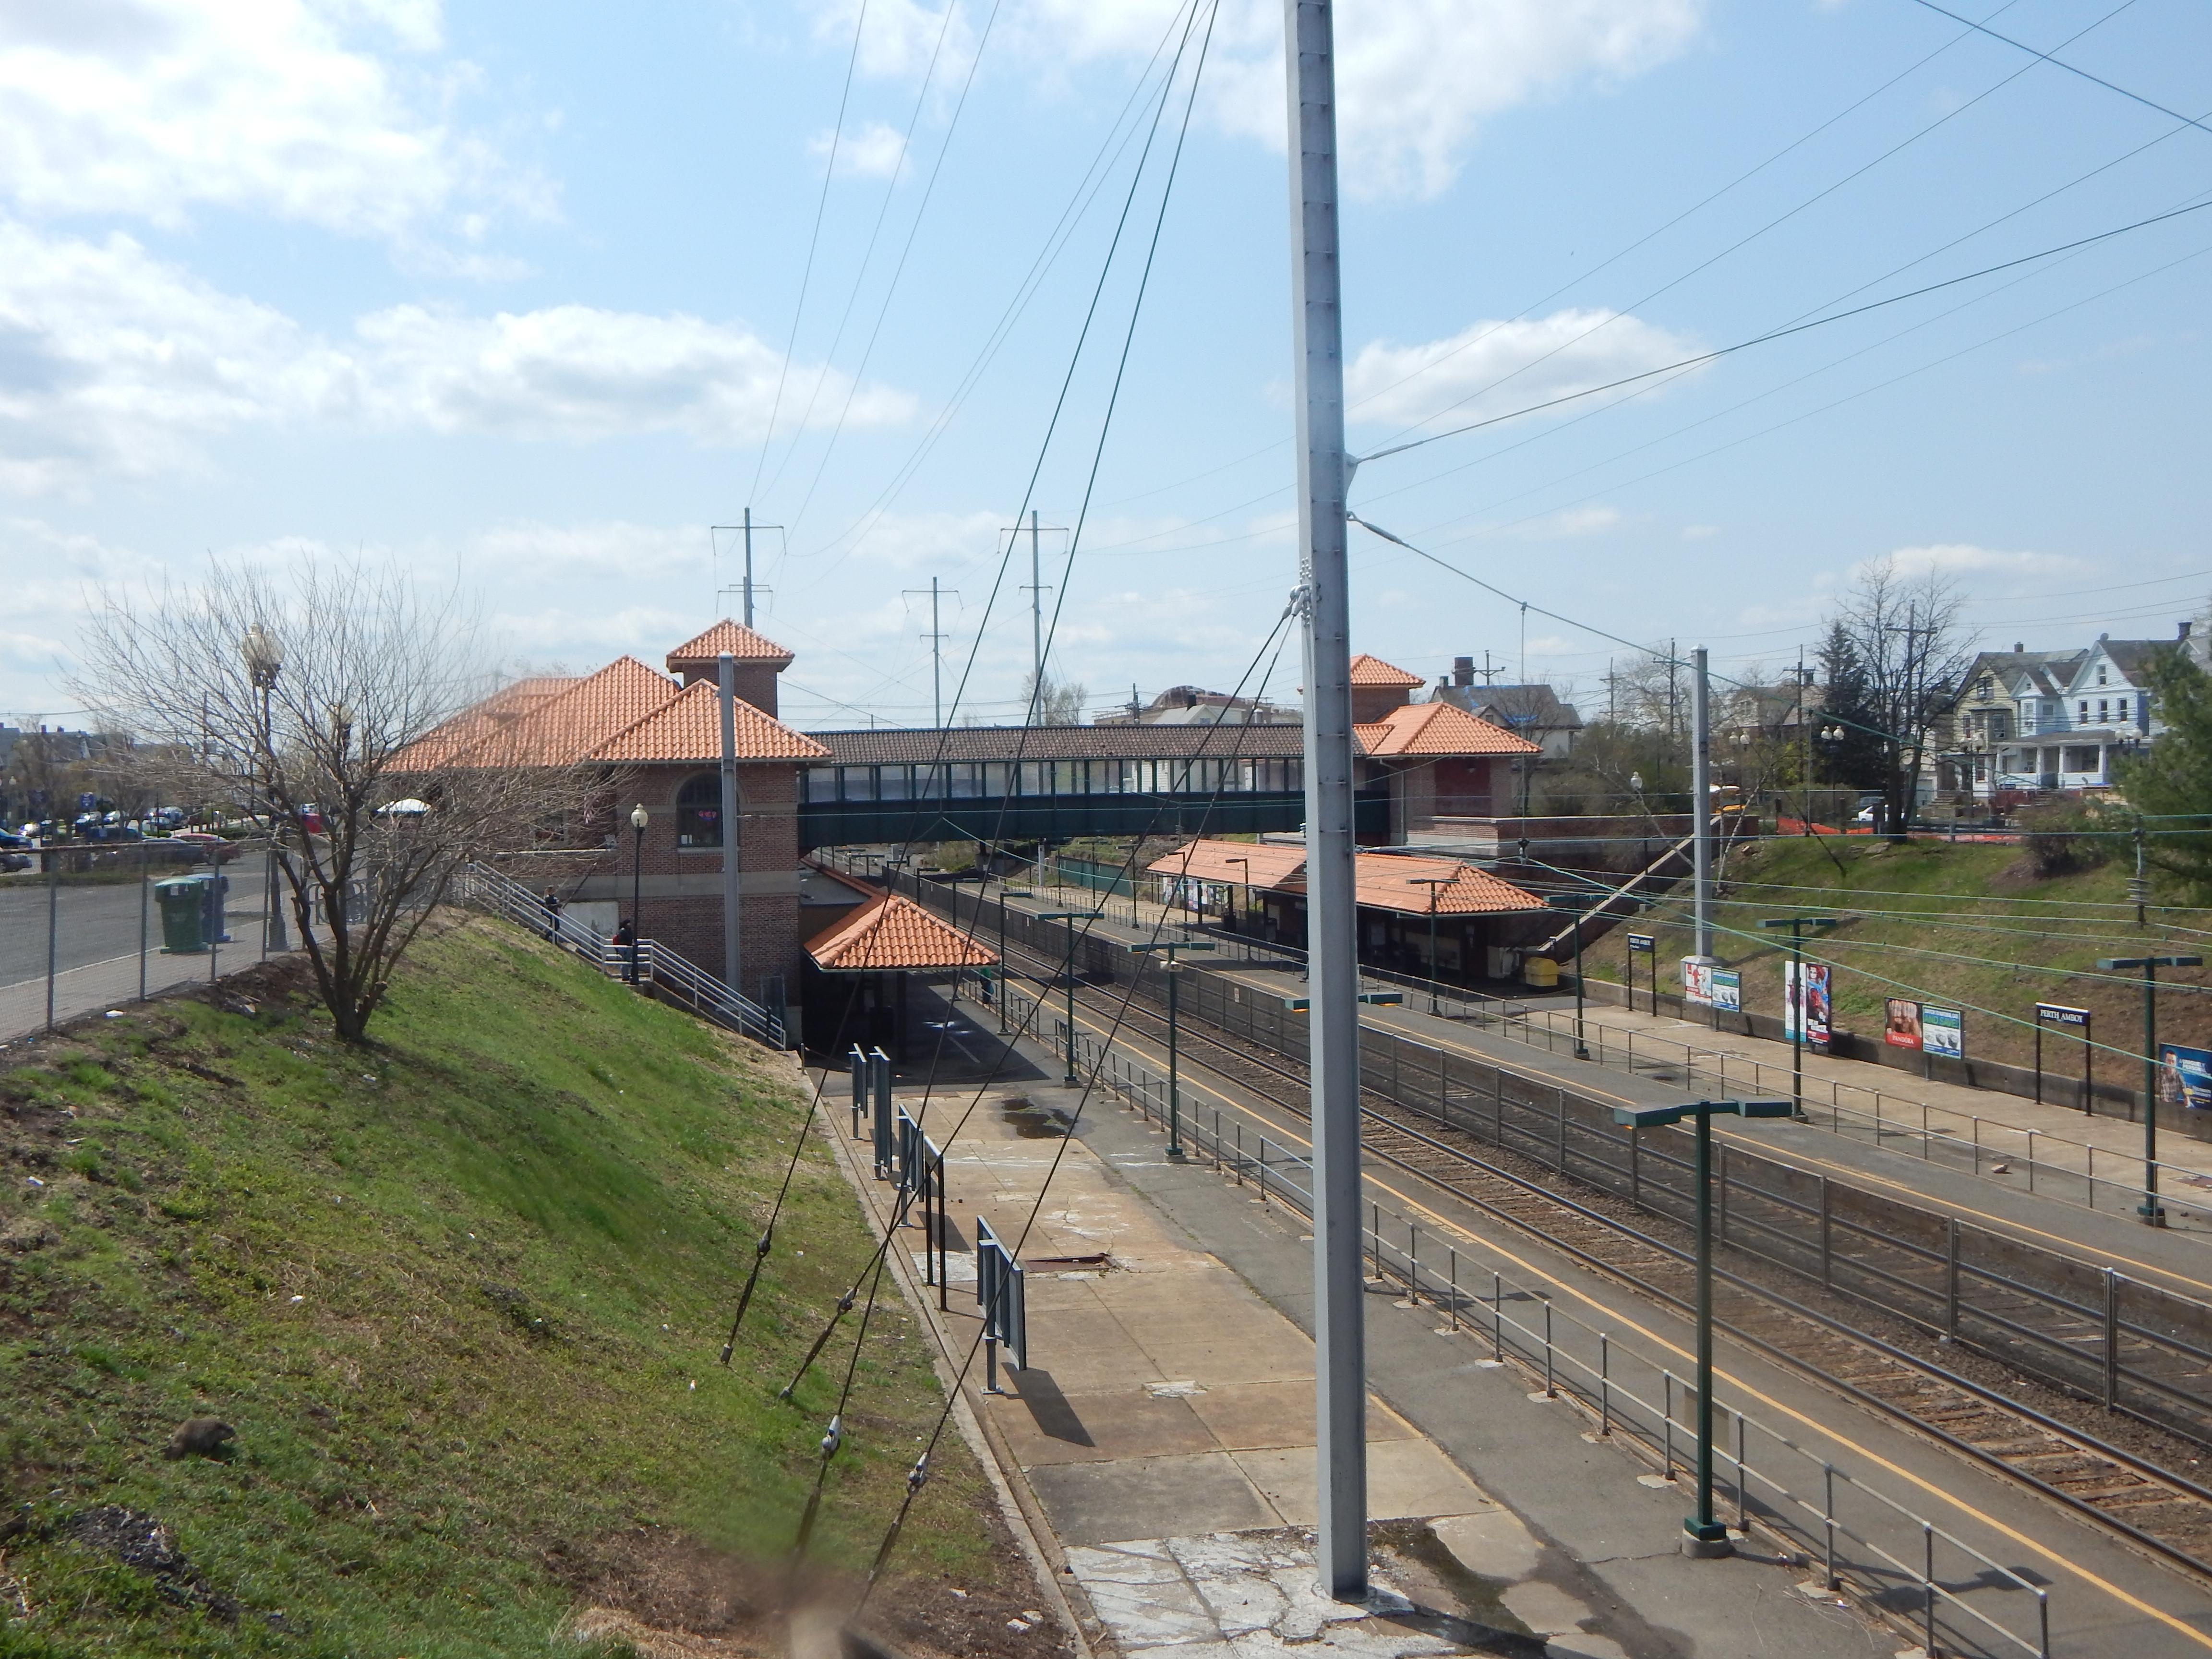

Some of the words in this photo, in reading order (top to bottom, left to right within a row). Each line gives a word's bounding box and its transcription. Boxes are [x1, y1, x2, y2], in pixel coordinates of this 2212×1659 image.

[2040, 1009, 2059, 1019] PERTH
[2061, 1013, 2083, 1023] AMBOY
[1892, 1035, 1914, 1045] PANDORA
